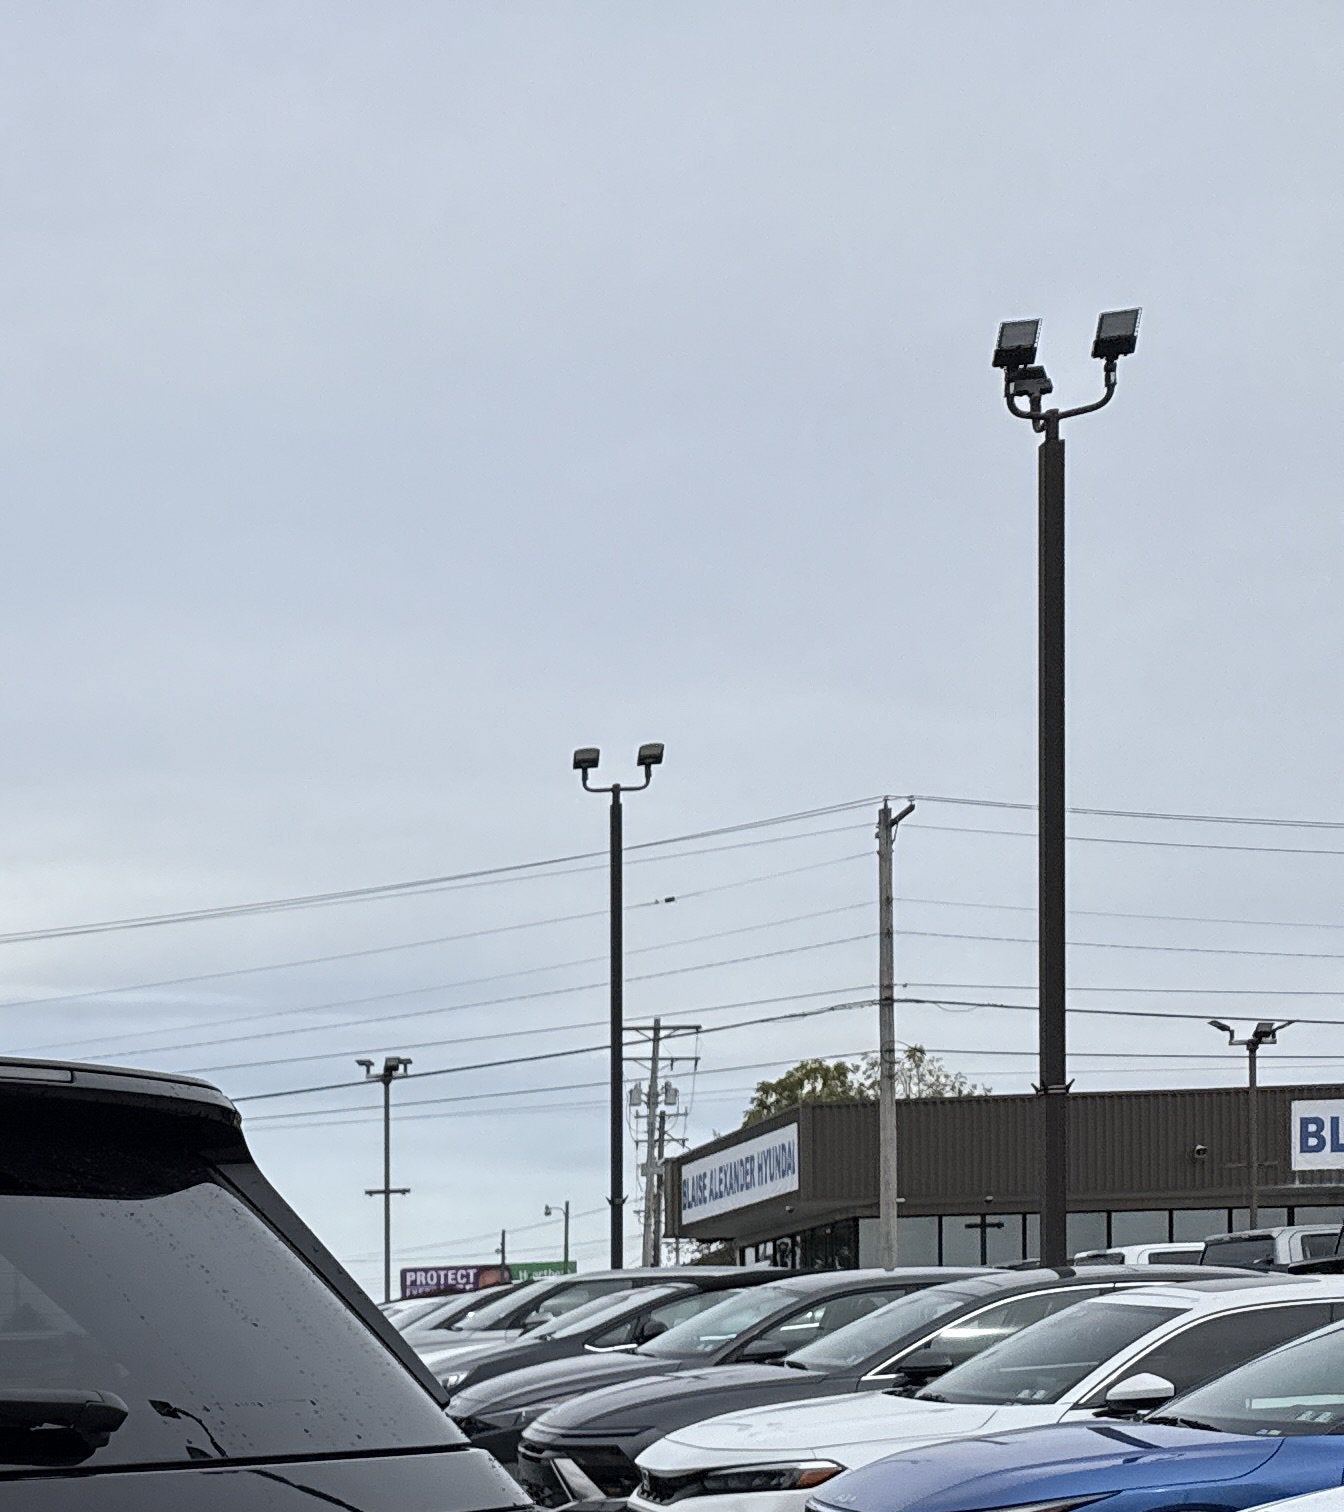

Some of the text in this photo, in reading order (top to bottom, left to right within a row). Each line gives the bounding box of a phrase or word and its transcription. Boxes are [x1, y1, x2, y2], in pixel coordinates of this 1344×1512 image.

[682, 1140, 796, 1211] BLAISE ALEXANDER HYUNDAI
[405, 1268, 478, 1286] PROTECT
